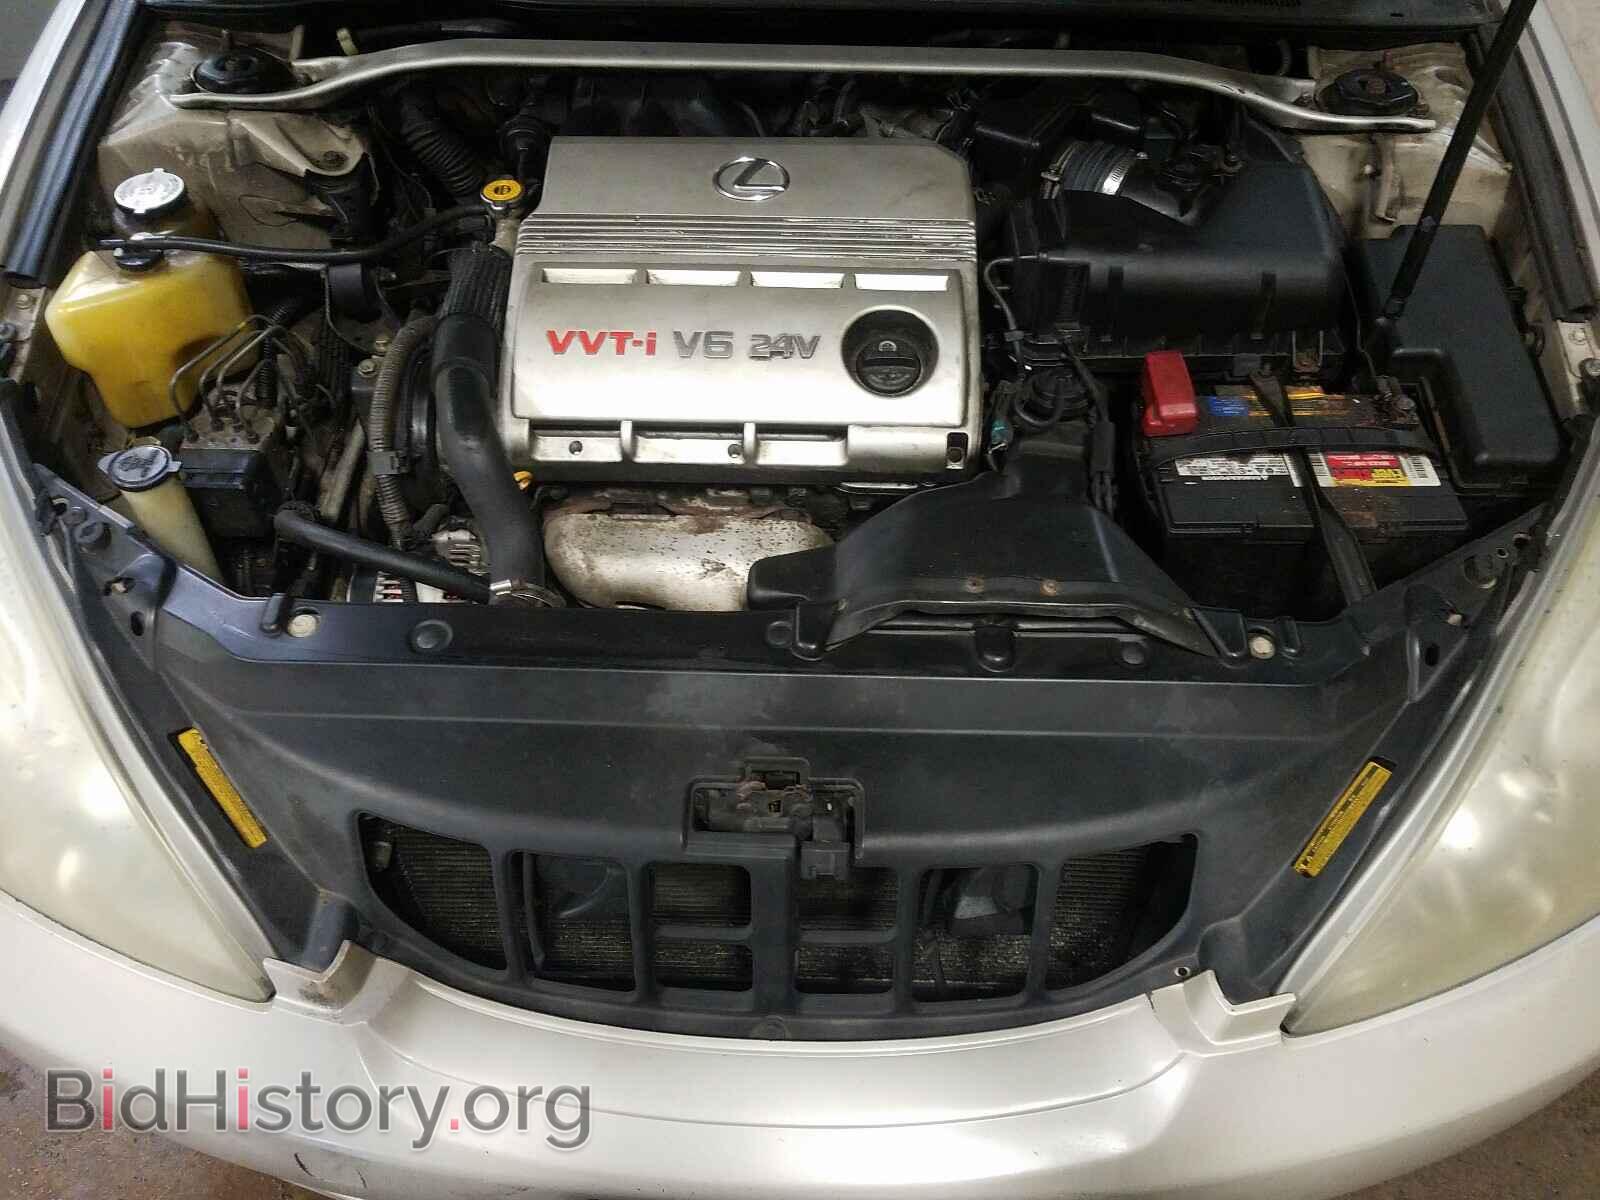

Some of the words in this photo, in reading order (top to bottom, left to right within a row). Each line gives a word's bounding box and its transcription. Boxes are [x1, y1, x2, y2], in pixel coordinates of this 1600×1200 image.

[547, 330, 656, 356] VVT-i
[673, 331, 734, 359] V6
[749, 333, 821, 361] 24V
